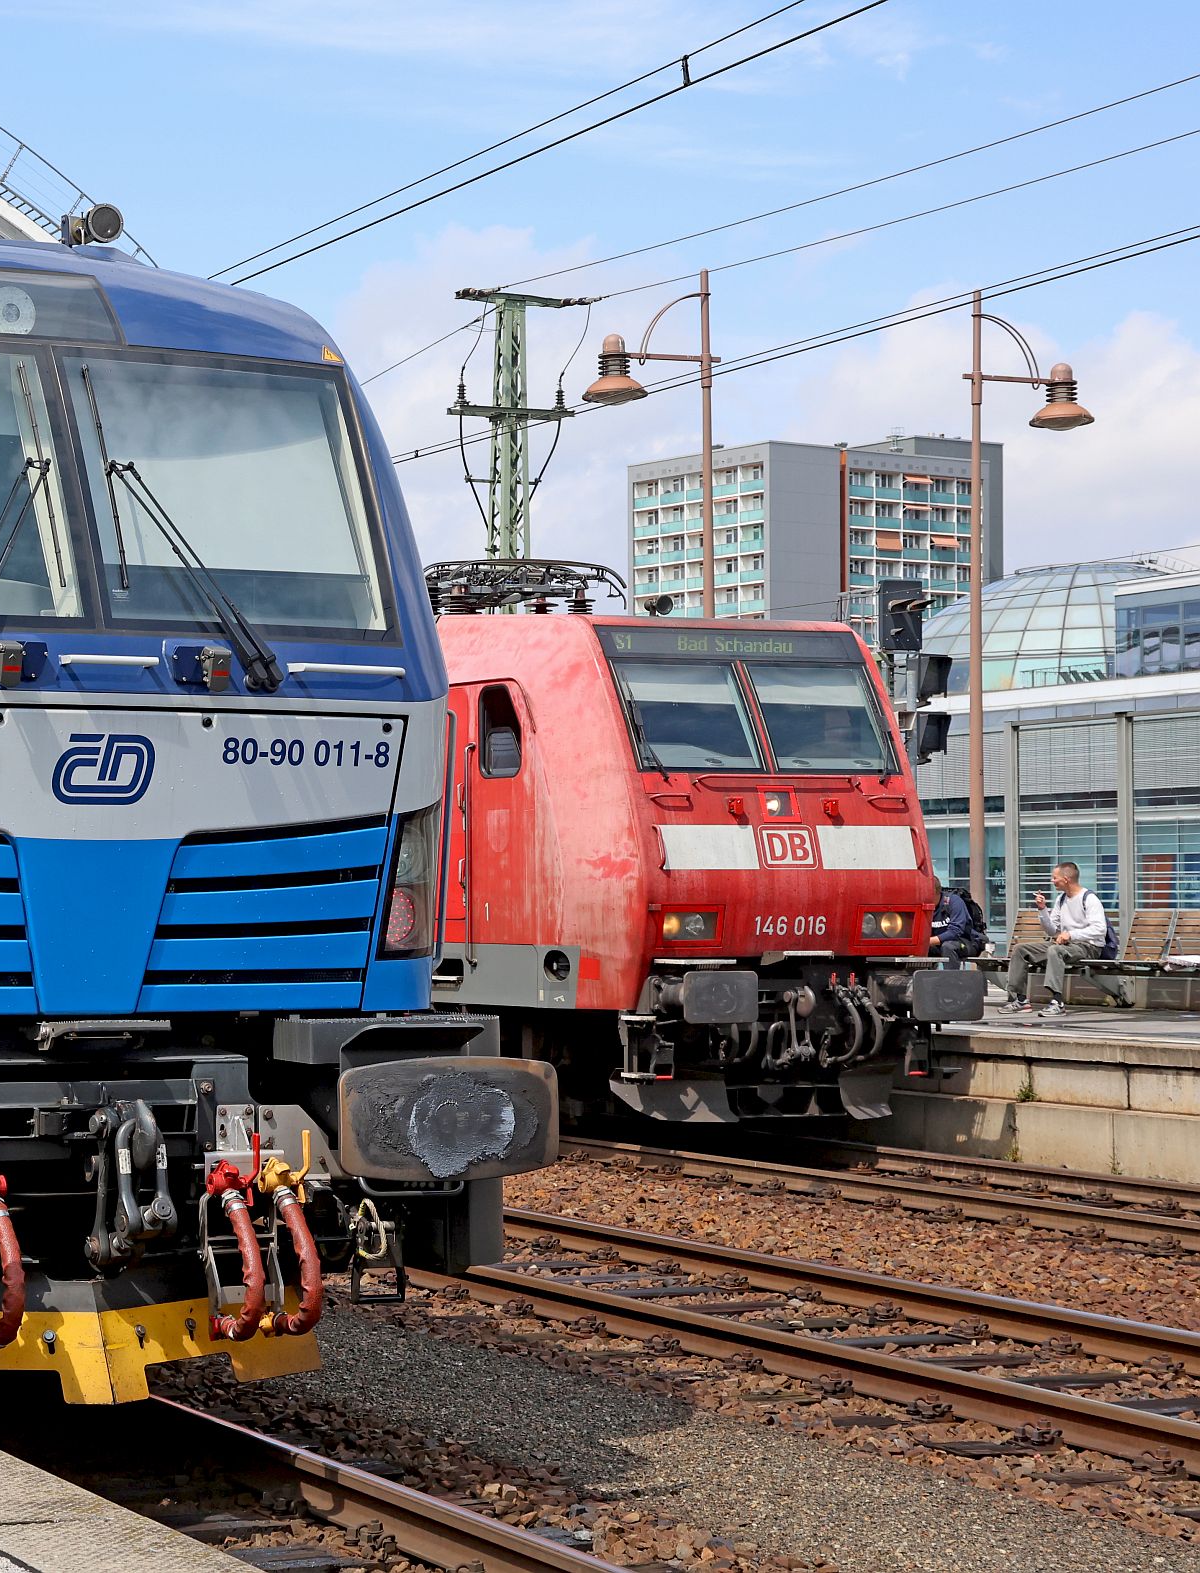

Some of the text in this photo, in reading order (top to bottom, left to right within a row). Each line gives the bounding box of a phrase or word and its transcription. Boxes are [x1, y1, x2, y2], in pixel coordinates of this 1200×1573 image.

[615, 633, 793, 654] S1 Bad Schandau
[222, 736, 391, 768] 80-90 011-8
[766, 832, 810, 861] DB
[755, 915, 827, 936] 146 016
